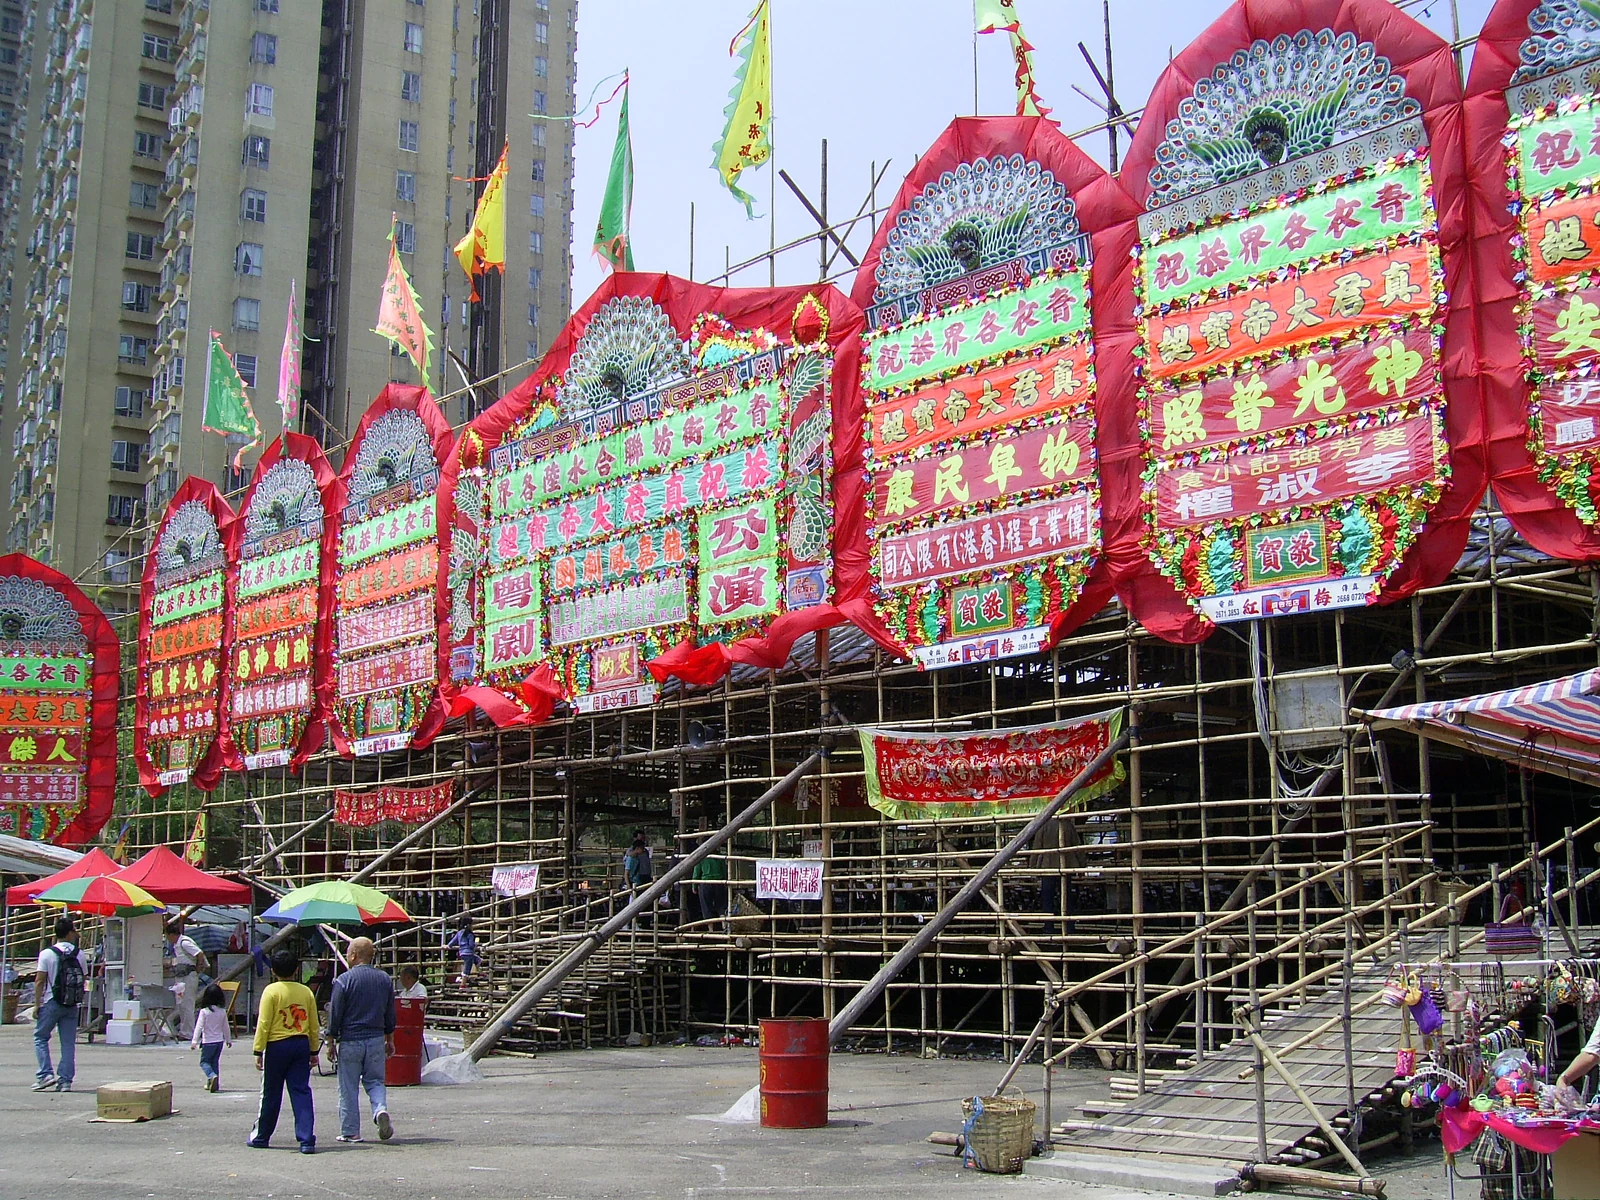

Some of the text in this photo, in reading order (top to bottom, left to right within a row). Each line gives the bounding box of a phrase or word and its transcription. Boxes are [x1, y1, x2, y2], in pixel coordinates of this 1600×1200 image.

[1530, 121, 1598, 176] 祝
[1153, 182, 1412, 291] 青衣各界恭祝
[876, 286, 1077, 377] 青衣各界恭祝
[1547, 294, 1600, 358] 安
[1162, 340, 1425, 451] 神光普照
[884, 427, 1081, 517] 物阜民康
[1174, 427, 1407, 488] 葵芳強記小食
[1174, 450, 1410, 520] 李淑權
[345, 504, 434, 556] 青衣各界恭祝
[884, 503, 1085, 579] 偉業工程(香港)有限公司
[1256, 531, 1319, 574] 敬賀
[708, 508, 768, 617] 公演
[491, 570, 536, 664] 粵劇
[957, 587, 1005, 626] 敬賀
[1242, 599, 1259, 615] 紅
[1314, 587, 1332, 607] 梅
[0, 663, 81, 684] 青衣各
[151, 659, 215, 696] 神光普照
[236, 639, 309, 678] 酬謝神恩
[599, 650, 633, 677] 笑納
[0, 700, 82, 722] 真君大
[8, 736, 77, 762] 人傑
[760, 867, 819, 893] 保持場地清潔
